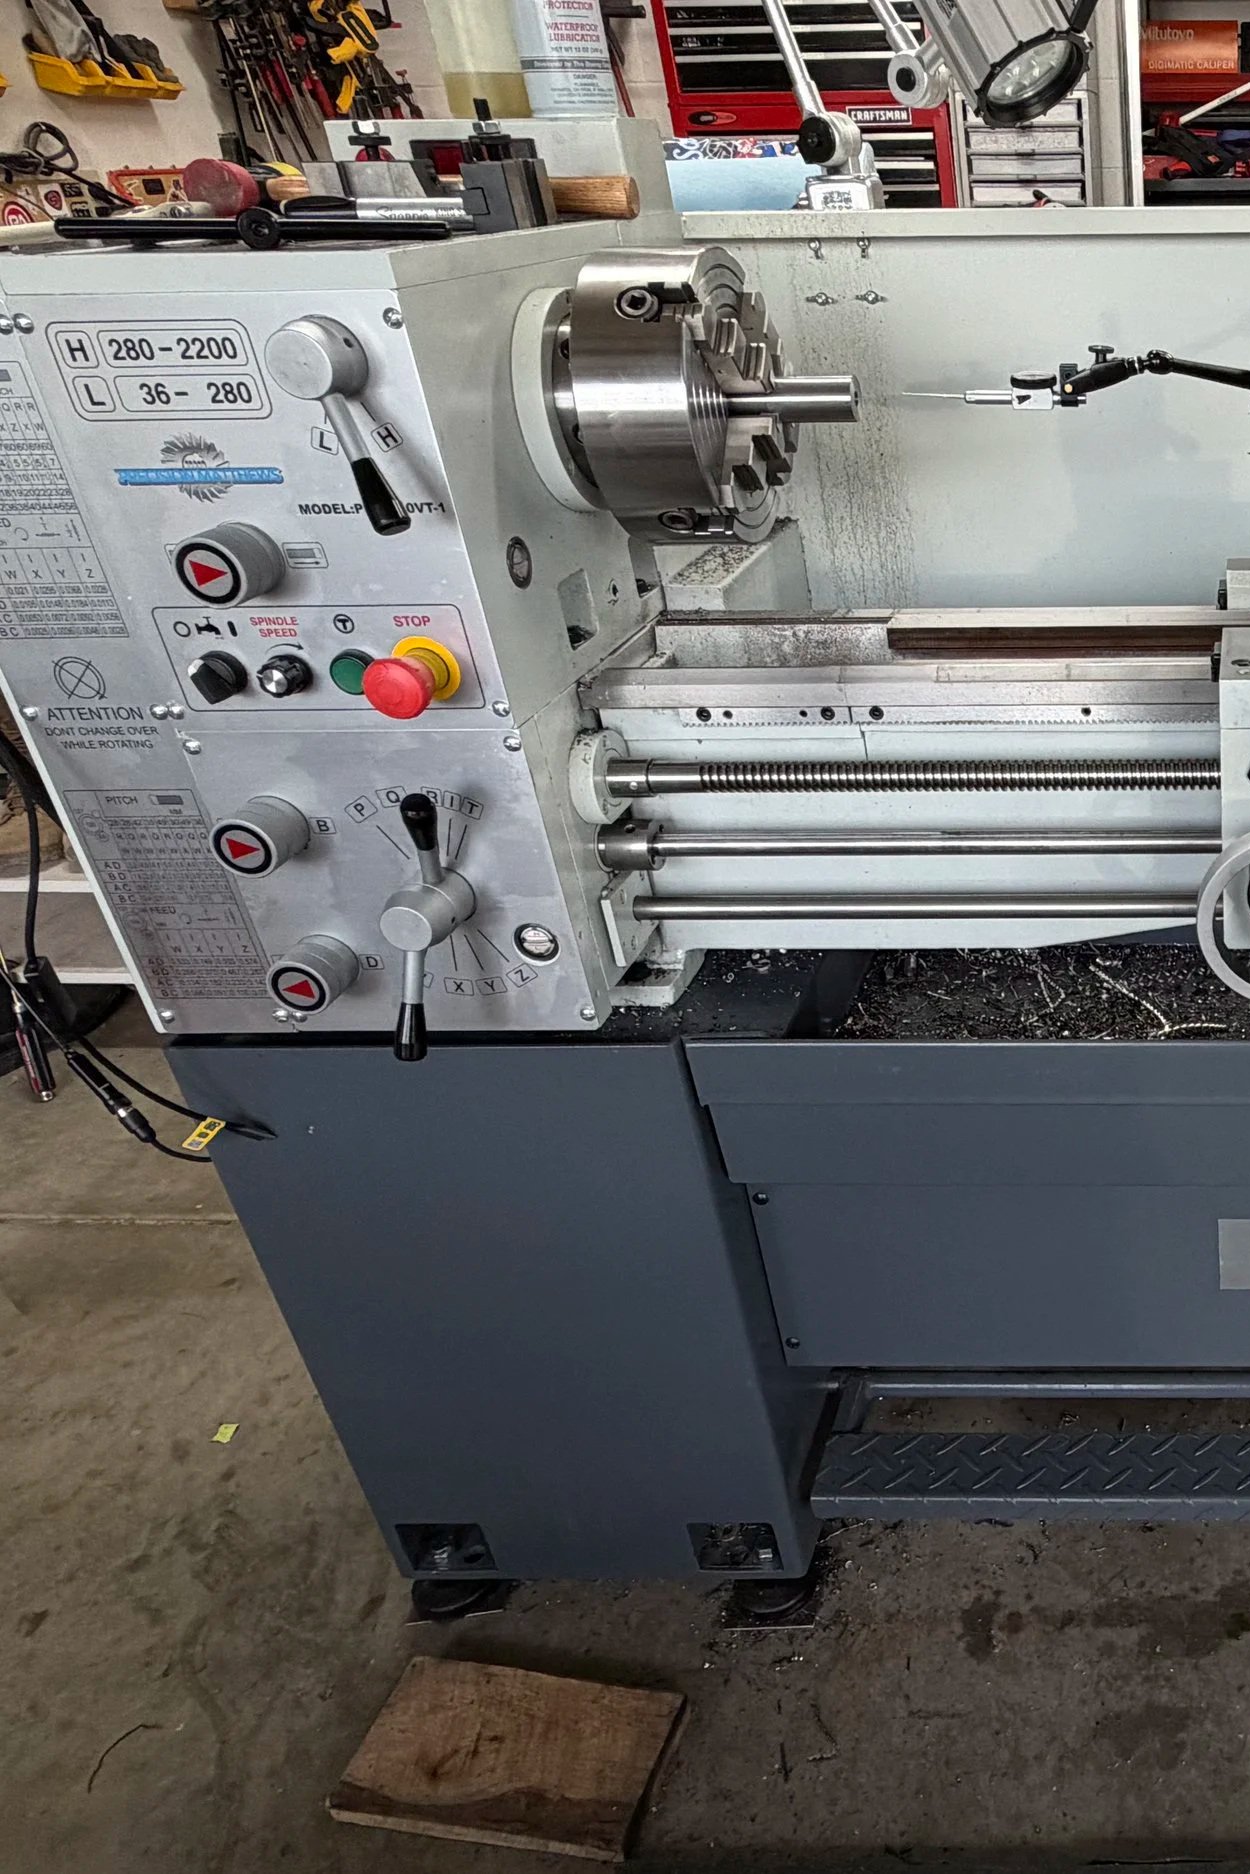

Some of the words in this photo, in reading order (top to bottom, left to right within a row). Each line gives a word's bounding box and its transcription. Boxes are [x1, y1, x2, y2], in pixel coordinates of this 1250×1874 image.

[1148, 60, 1194, 70] DIGIMATIC
[1196, 60, 1234, 69] CALIPER
[850, 110, 908, 122] CRAFTSMAN
[65, 339, 90, 362] H
[84, 383, 106, 406] L
[207, 381, 253, 404] 280
[318, 433, 333, 451] L
[376, 427, 398, 447] H
[249, 616, 299, 626] SPINDLE
[393, 615, 431, 627] STOP
[259, 627, 298, 638] SPEED
[48, 706, 145, 721] ATTENTION
[44, 727, 76, 737] DONT
[79, 726, 126, 736] CHANGE
[127, 726, 159, 736] OVER
[60, 740, 97, 750] WHILE
[99, 739, 154, 749] ROTATING
[105, 796, 138, 805] PITCH
[354, 803, 367, 817] P
[386, 790, 401, 805] Q
[464, 801, 480, 815] T
[316, 821, 329, 832] B
[150, 906, 176, 914] FEED
[367, 956, 378, 968] D
[514, 970, 529, 983] Z
[453, 980, 464, 993] X
[485, 979, 497, 992] Y
